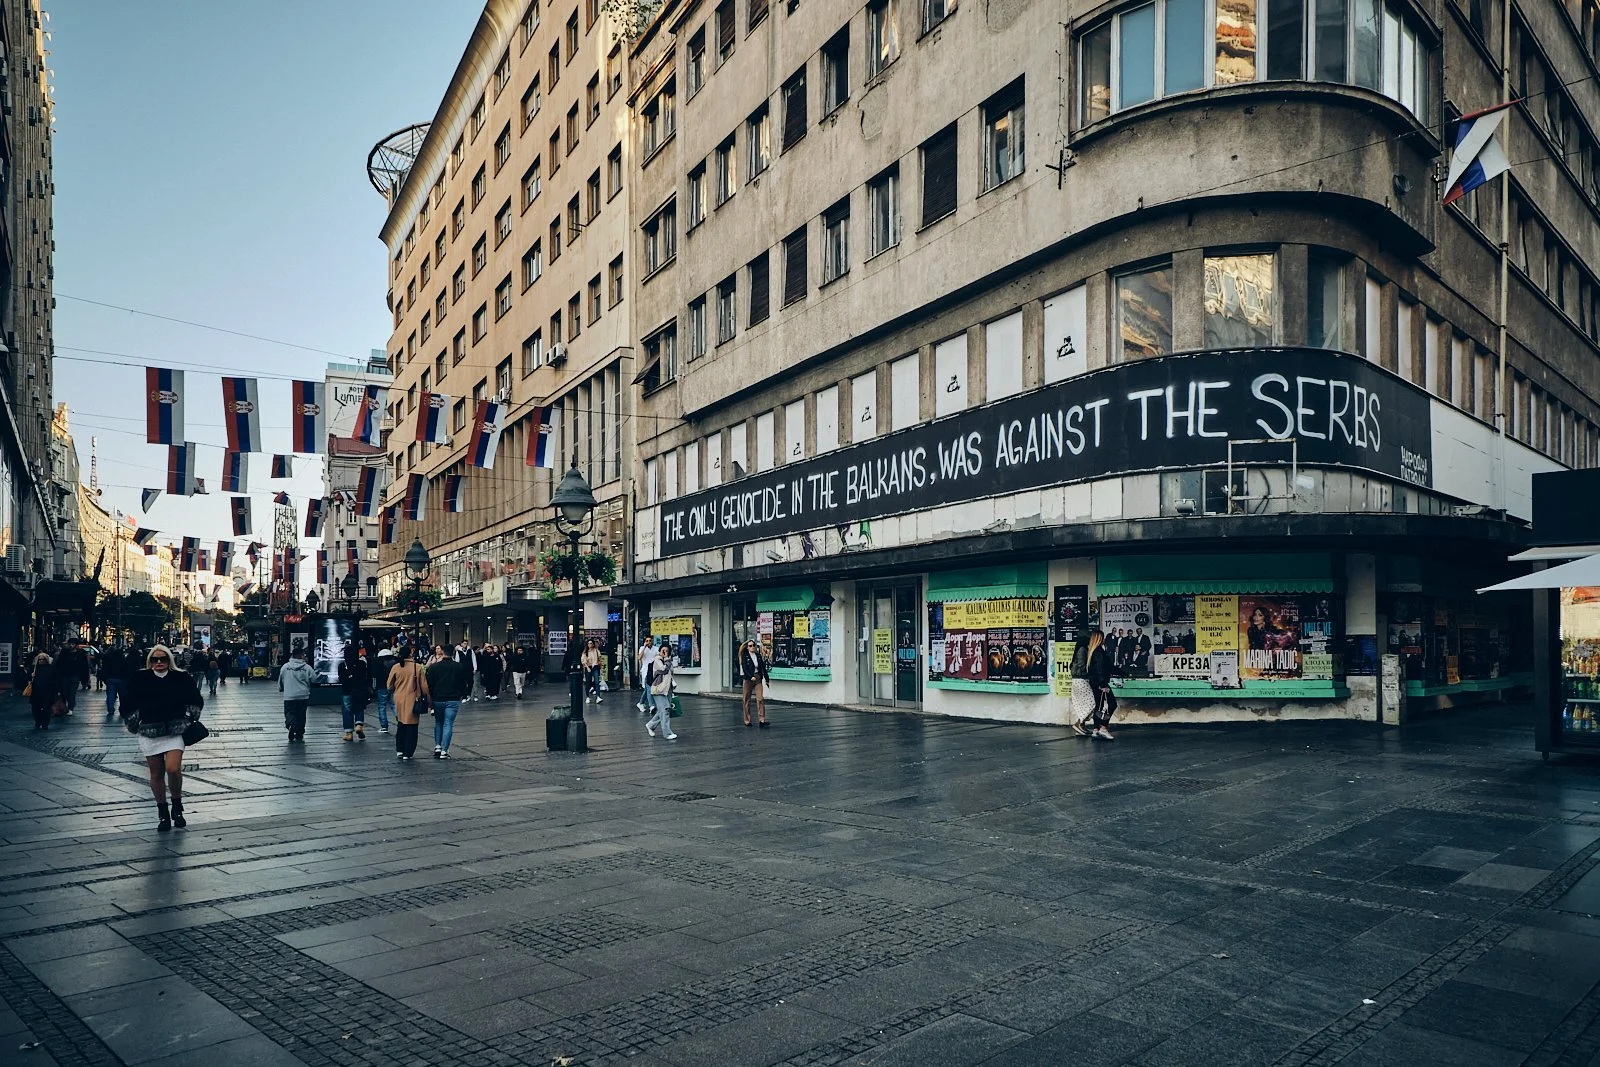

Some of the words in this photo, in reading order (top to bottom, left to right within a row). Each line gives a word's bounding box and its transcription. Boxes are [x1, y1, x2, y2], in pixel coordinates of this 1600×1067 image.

[334, 386, 363, 407] LUMIE
[349, 386, 364, 394] HOTE
[664, 511, 686, 543] THE
[688, 500, 717, 537] ONLY
[721, 484, 786, 530] GENOCIDE
[791, 478, 804, 516] IN
[807, 470, 839, 511] THE
[938, 431, 982, 480] WAS
[995, 398, 1110, 469] AGAINST
[1127, 380, 1231, 441] THE
[1250, 372, 1381, 453] SERBS
[1022, 600, 1045, 613] LUKAS
[1105, 600, 1149, 614] LEGENDE
[966, 631, 986, 644] Дора
[1243, 649, 1274, 669] MARINA
[1275, 647, 1298, 670] TADIĆ
